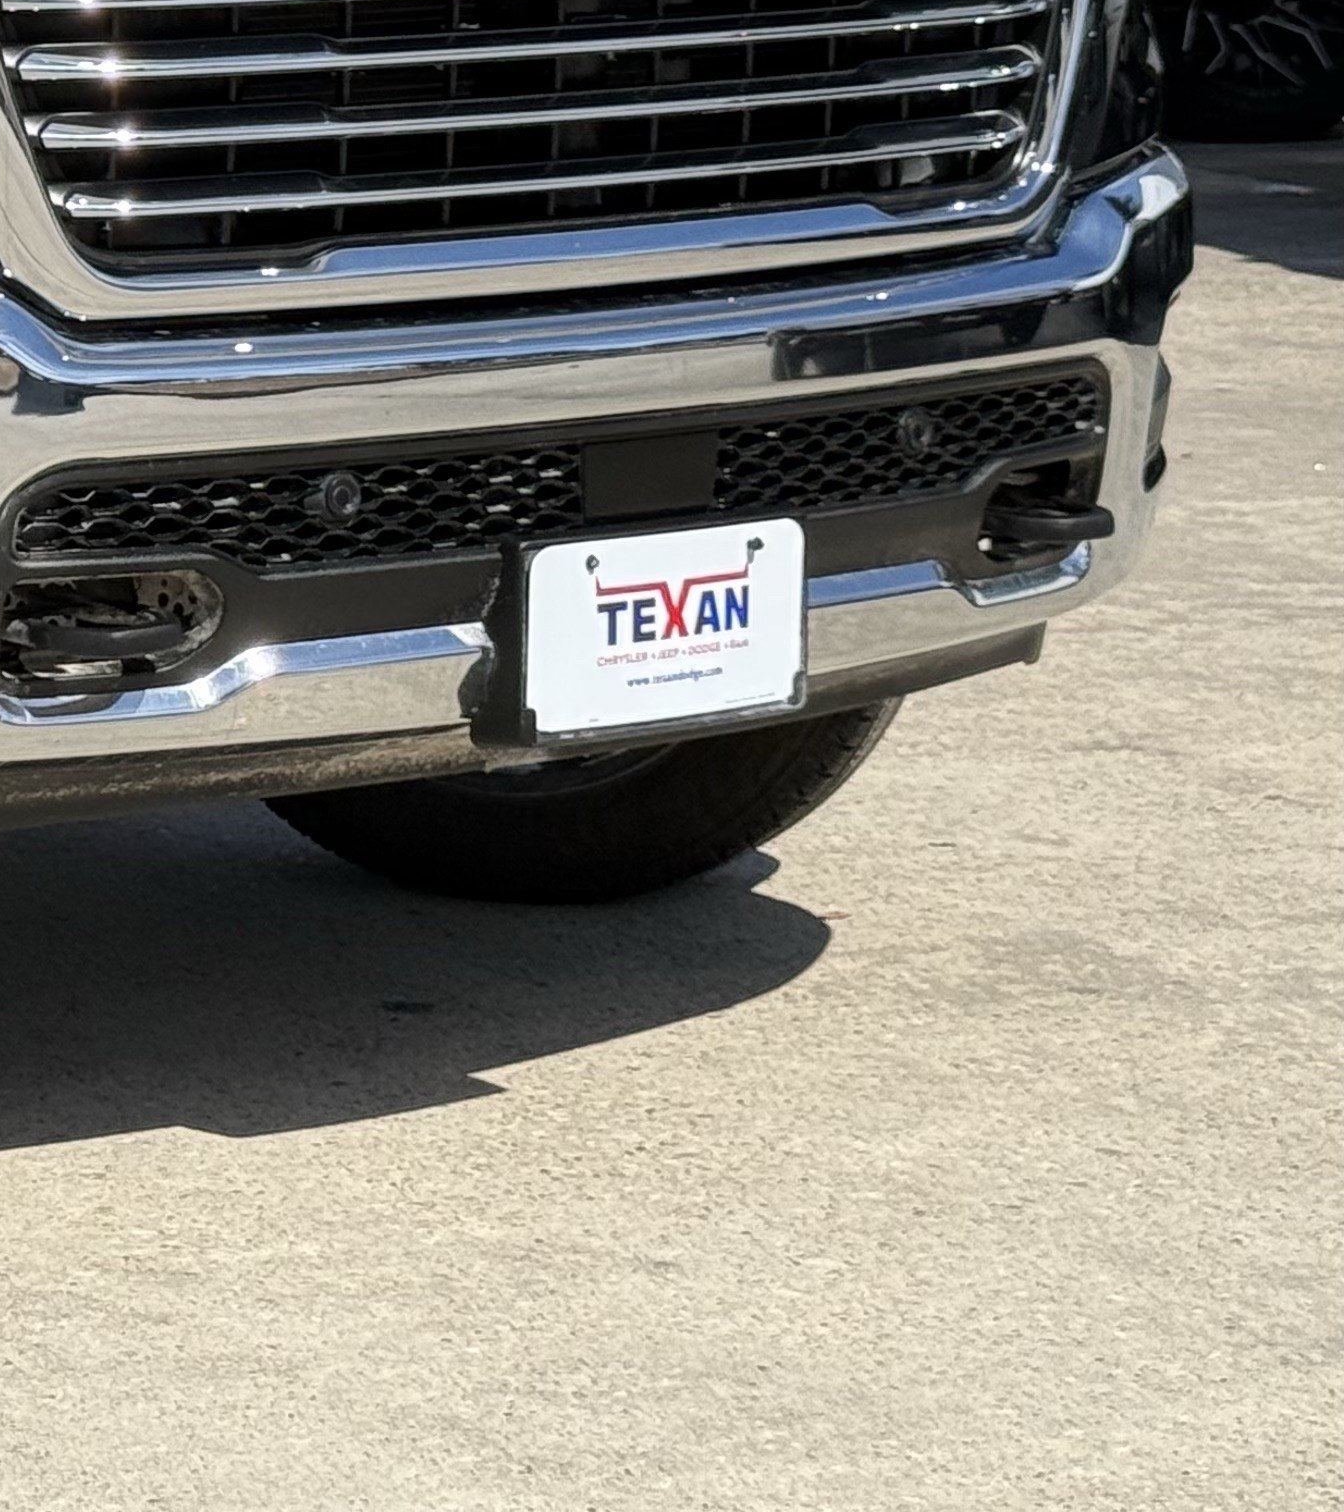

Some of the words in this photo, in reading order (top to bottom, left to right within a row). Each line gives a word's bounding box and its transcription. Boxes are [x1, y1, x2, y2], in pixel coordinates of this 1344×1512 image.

[596, 580, 750, 646] TEXAN
[596, 651, 648, 667] CHRYSLER
[688, 641, 721, 656] DODGE
